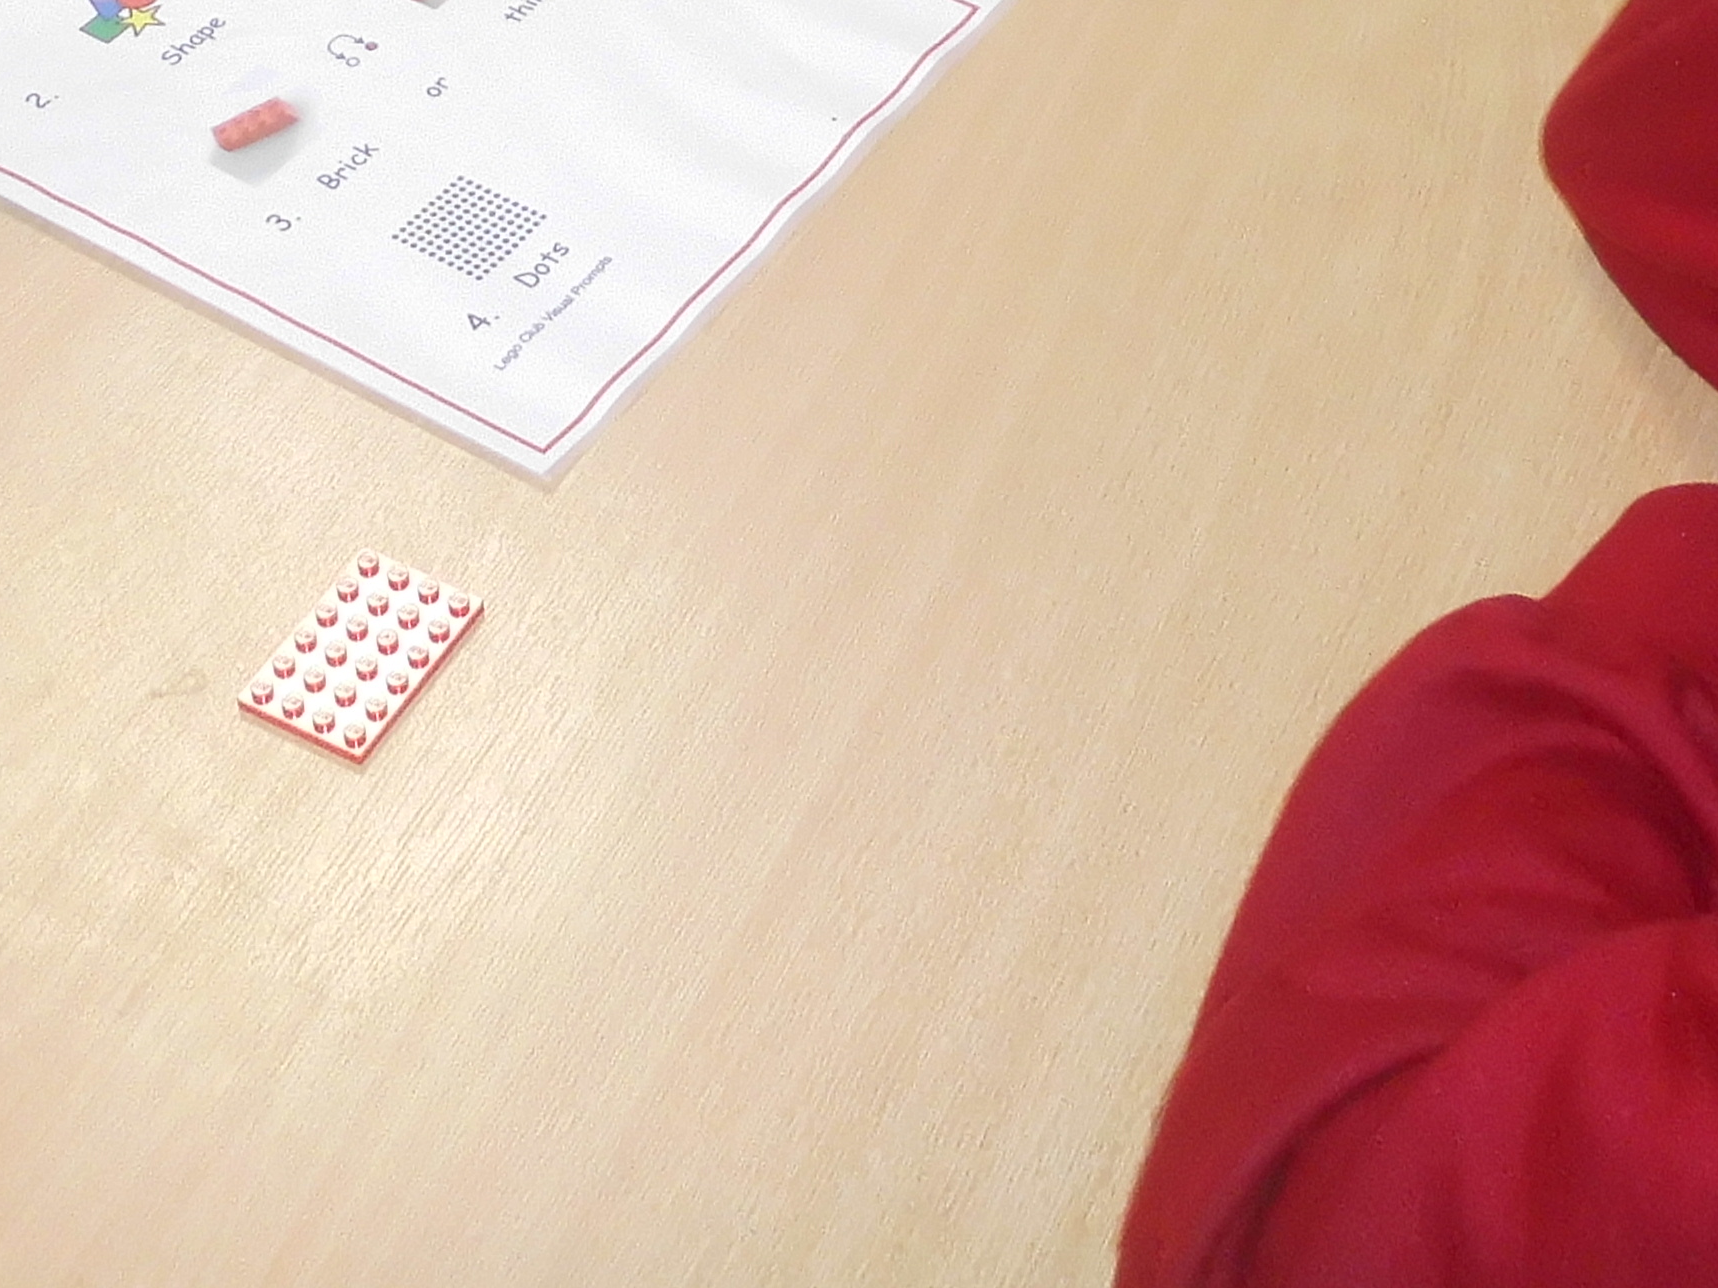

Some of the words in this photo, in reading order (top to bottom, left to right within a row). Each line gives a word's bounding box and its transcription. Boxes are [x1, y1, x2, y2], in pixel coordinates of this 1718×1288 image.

[162, 14, 228, 67] Shape
[316, 141, 380, 192] Brick
[426, 74, 452, 98] or
[513, 242, 570, 288] Dots
[493, 344, 523, 370] Lego
[519, 323, 545, 343] Club
[541, 294, 575, 321] Visual
[570, 256, 613, 296] Prompts
